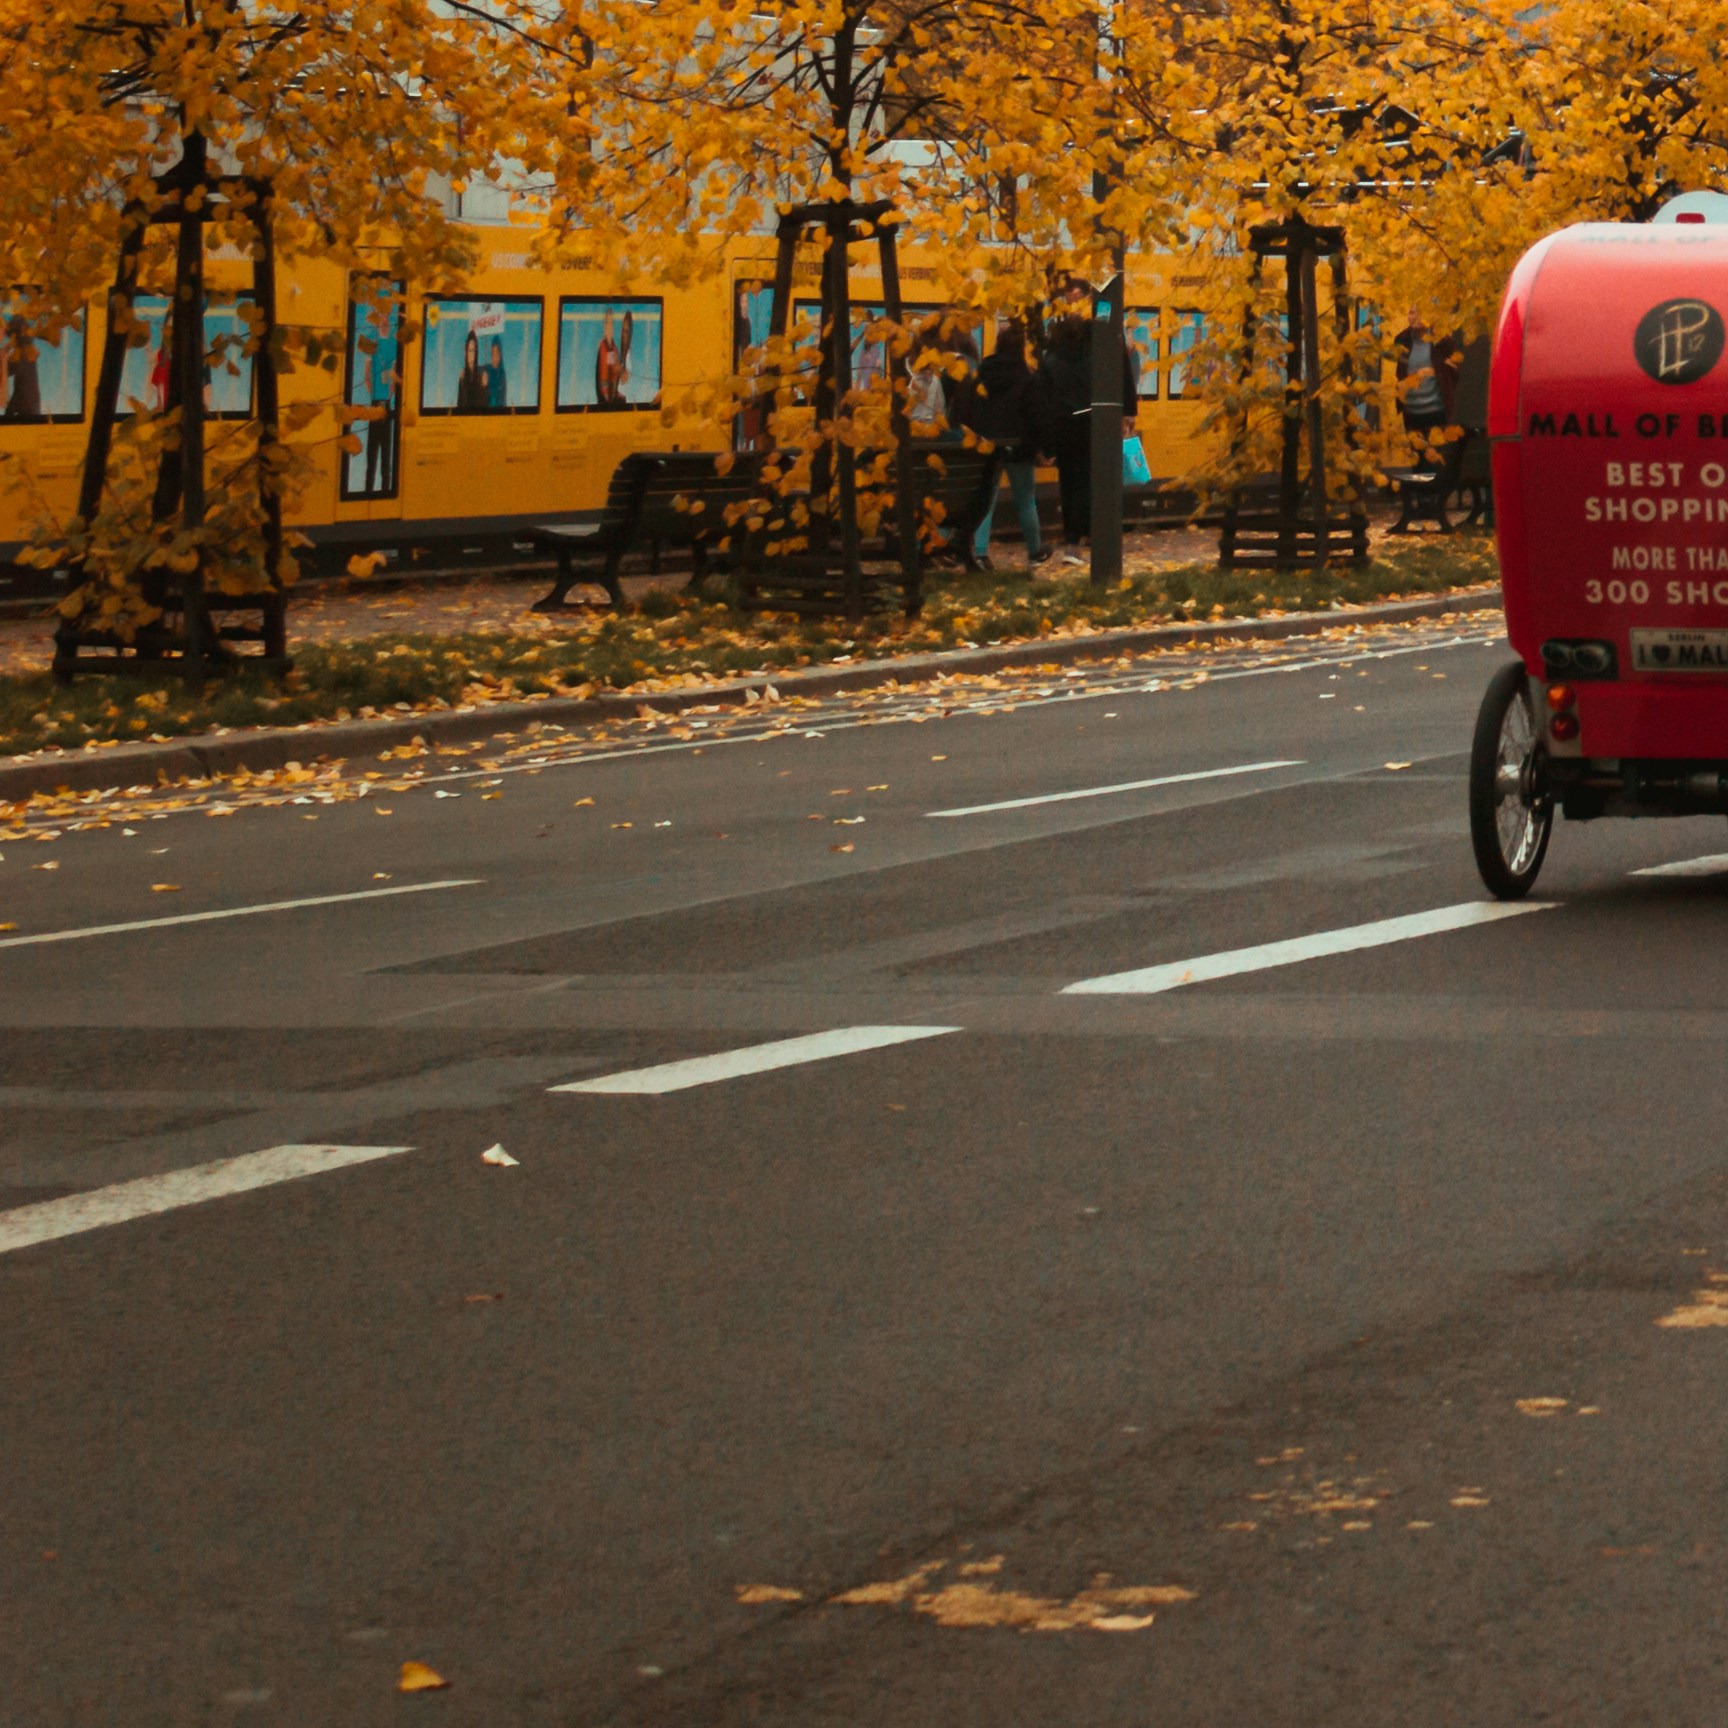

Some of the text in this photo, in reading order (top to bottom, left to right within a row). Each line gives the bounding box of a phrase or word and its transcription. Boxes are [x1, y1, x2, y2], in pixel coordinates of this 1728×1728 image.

[1527, 413, 1620, 438] MALL
[1635, 413, 1680, 439] OF
[1606, 462, 1685, 487] BEST
[1611, 545, 1677, 571] MORE
[1584, 579, 1651, 605] 300
